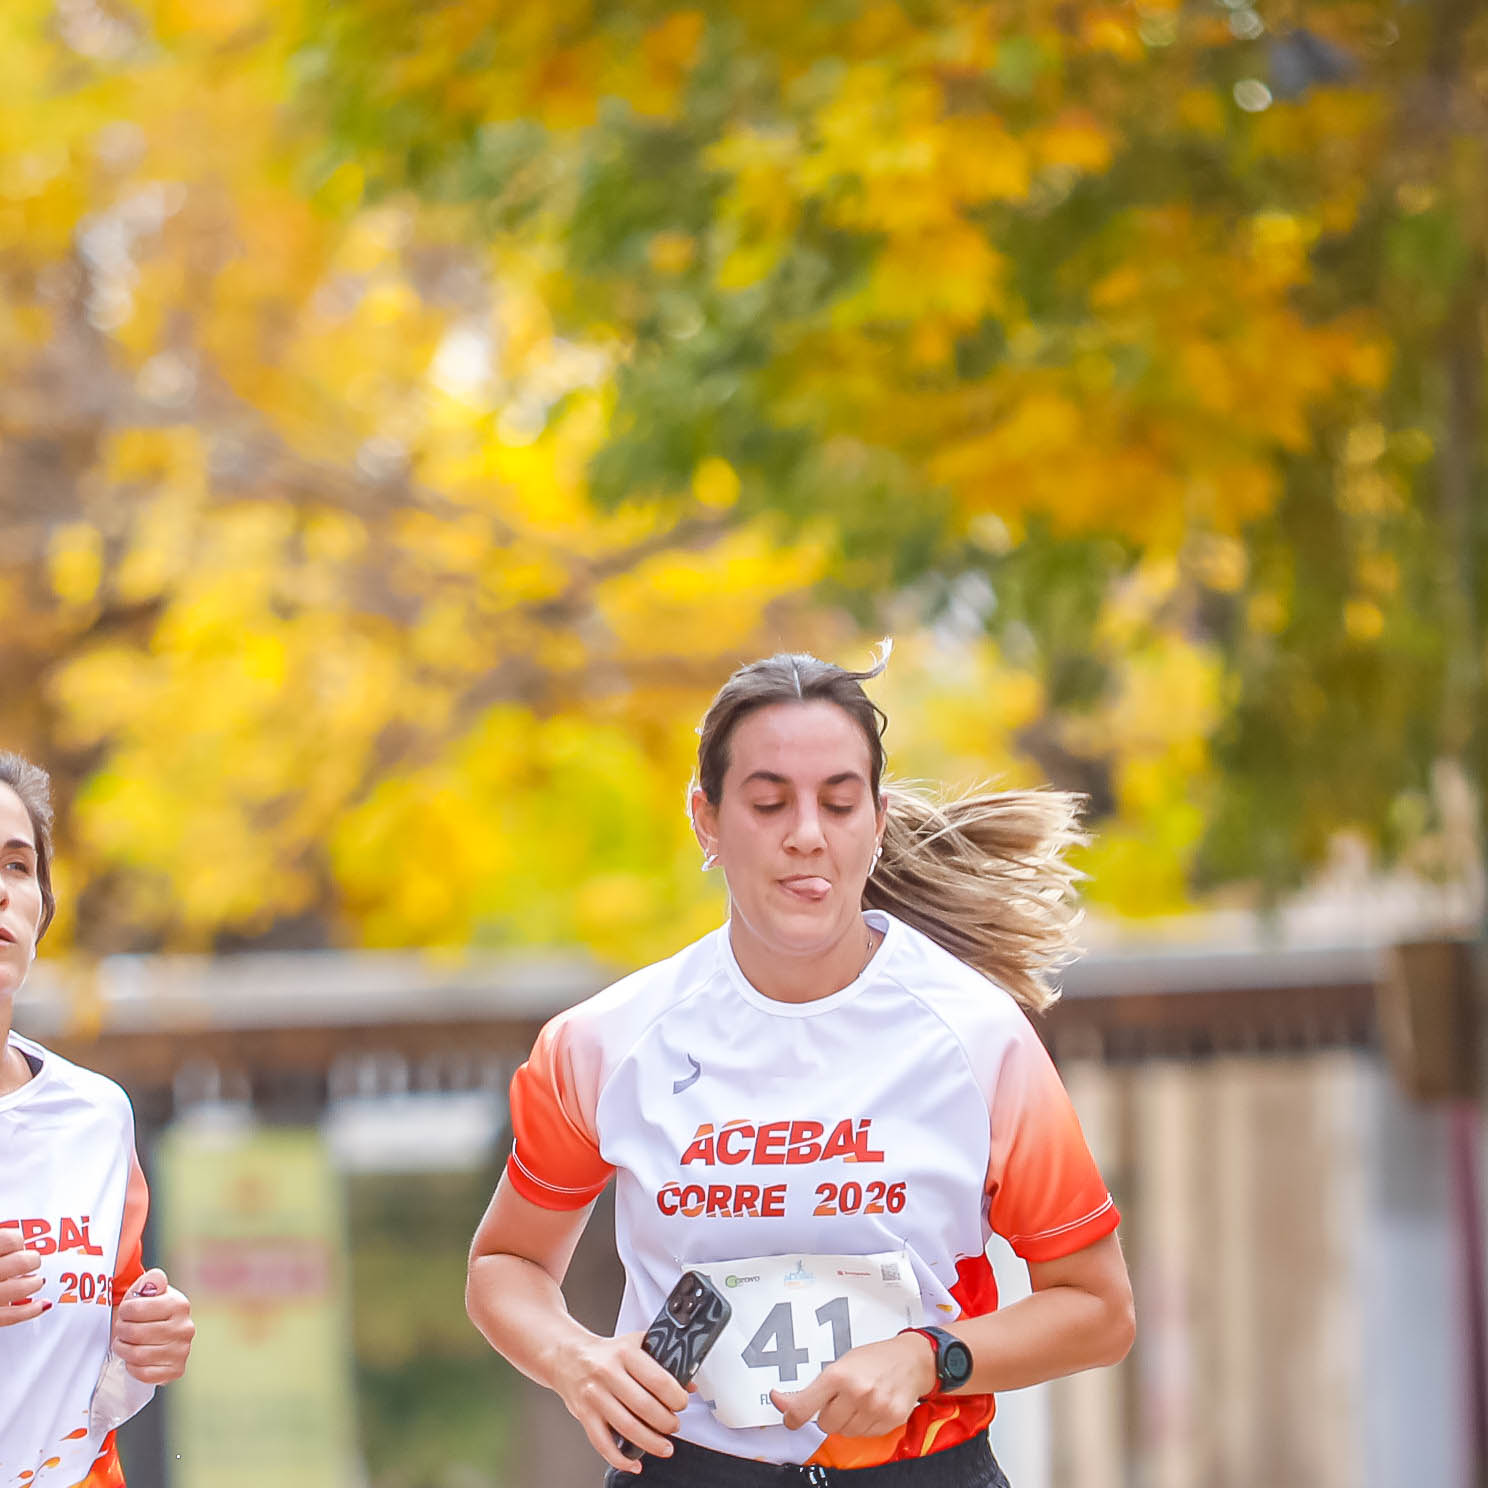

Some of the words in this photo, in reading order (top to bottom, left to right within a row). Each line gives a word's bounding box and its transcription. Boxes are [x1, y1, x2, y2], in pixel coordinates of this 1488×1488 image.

[680, 1118, 885, 1166] ACEBAL
[656, 1181, 788, 1218] CORRE
[812, 1181, 907, 1217] 2026
[741, 1297, 852, 1382] 41
